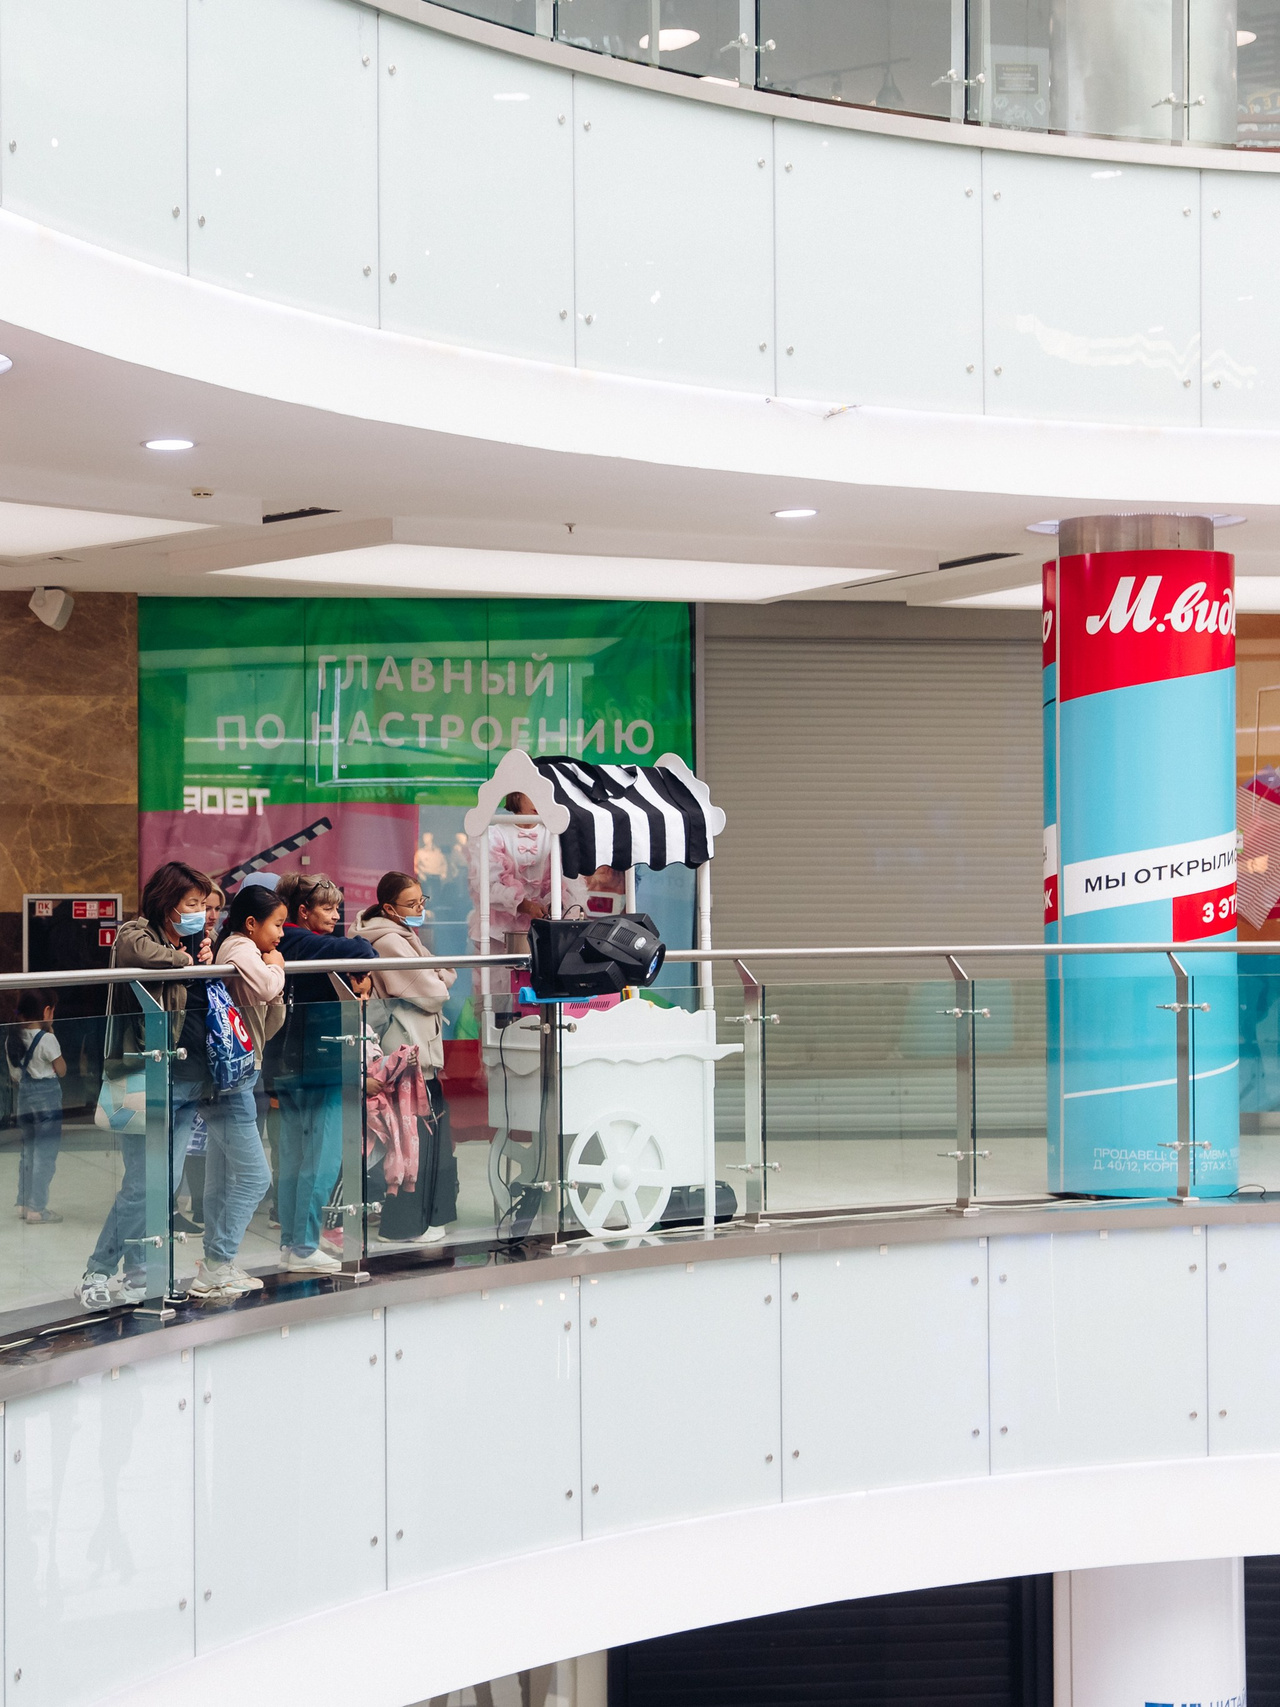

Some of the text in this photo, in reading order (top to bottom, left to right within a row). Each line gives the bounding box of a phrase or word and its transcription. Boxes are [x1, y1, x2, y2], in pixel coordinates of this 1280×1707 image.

[1085, 575, 1236, 637] М.вид
[318, 652, 554, 697] ГЛАВНЫЙ
[216, 710, 655, 756] ПО НАСТРОЕНИЮ
[1085, 871, 1126, 893] МЫ
[1093, 1147, 1167, 1162] ПРОДАВЕЦ:
[1093, 1160, 1105, 1171] Д.
[1109, 1159, 1141, 1173] 40/12,
